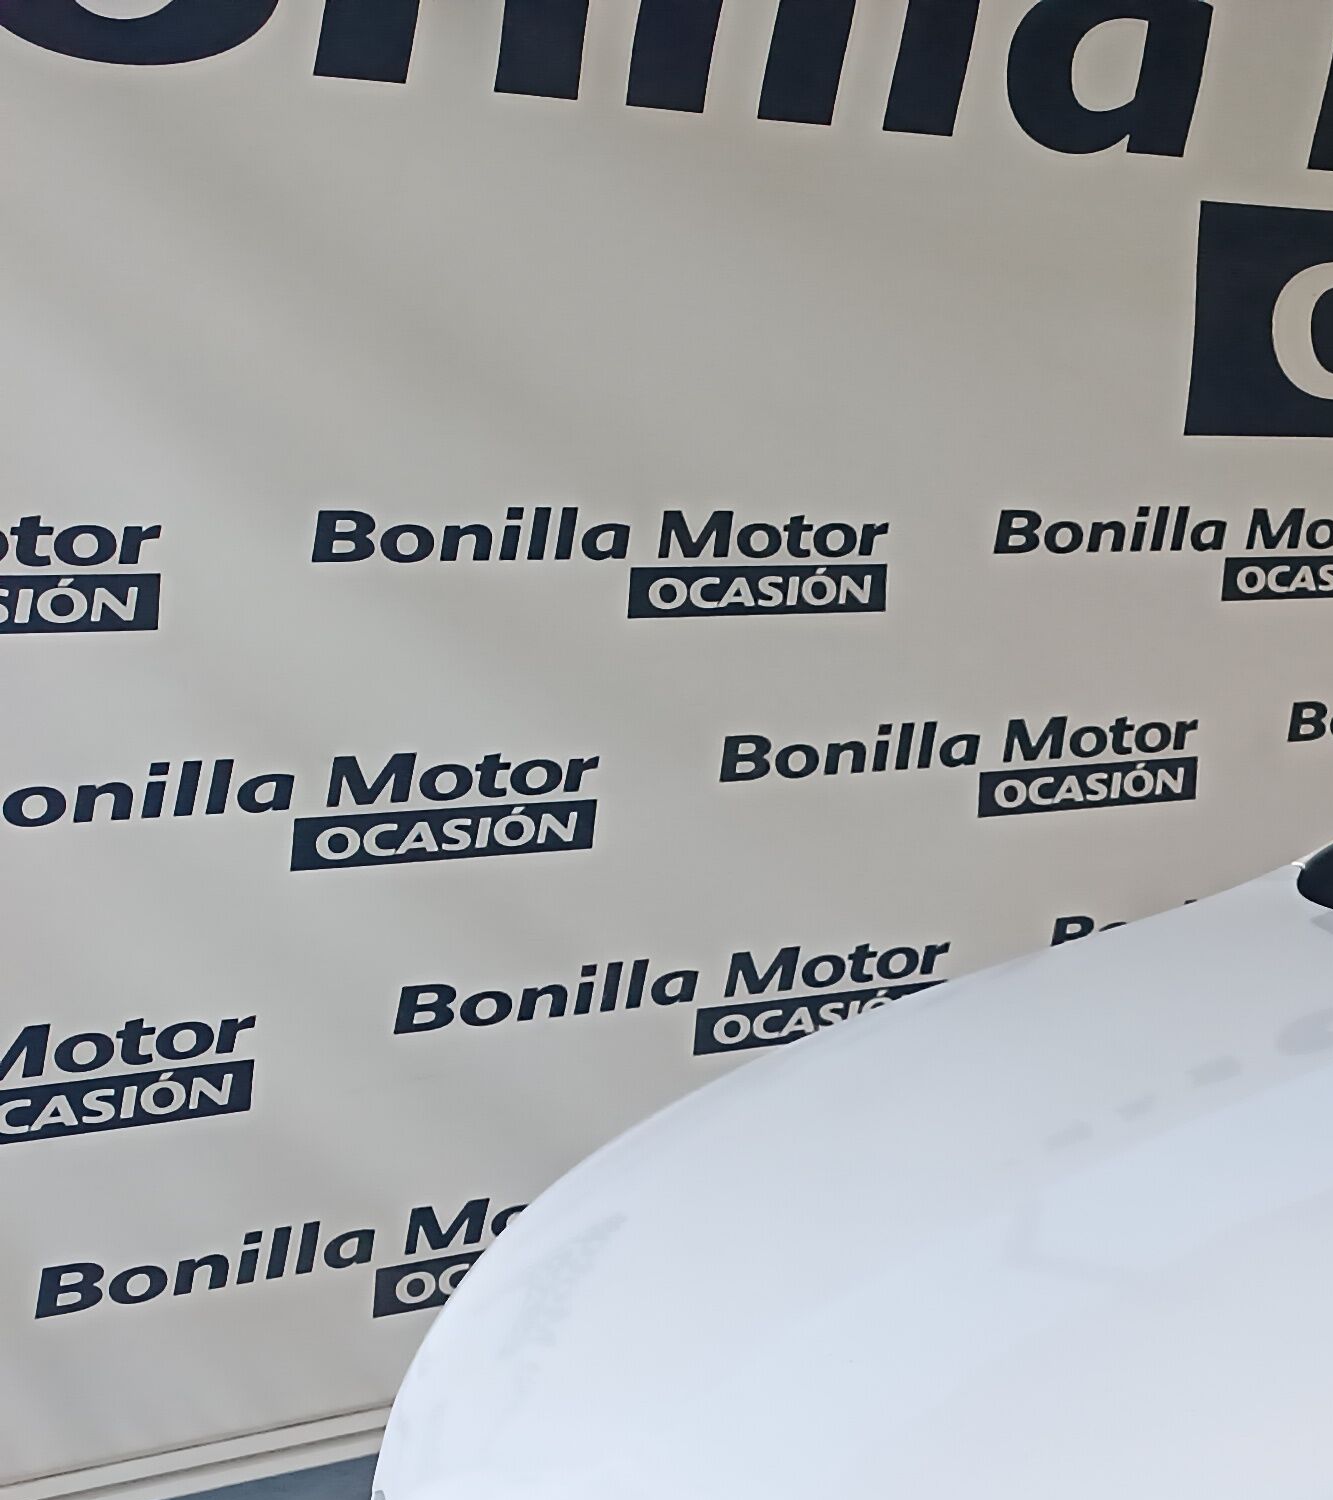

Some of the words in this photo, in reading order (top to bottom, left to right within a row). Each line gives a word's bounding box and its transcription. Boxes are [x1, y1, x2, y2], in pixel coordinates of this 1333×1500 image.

[0, 515, 161, 567] tor
[311, 507, 630, 563] Bonilla
[658, 510, 889, 558] Motor
[993, 506, 1227, 554] Bonilla
[649, 568, 873, 610] OCASIÓN
[719, 720, 980, 783] Bonilla
[1003, 716, 1199, 763] Motor
[327, 752, 600, 808] Motor
[993, 762, 1185, 809] OCASIÓN
[315, 807, 579, 861] OCASIÓN
[394, 960, 698, 1035] Bonilla
[723, 941, 952, 998] Motor
[35, 1221, 375, 1320] Bonilla
